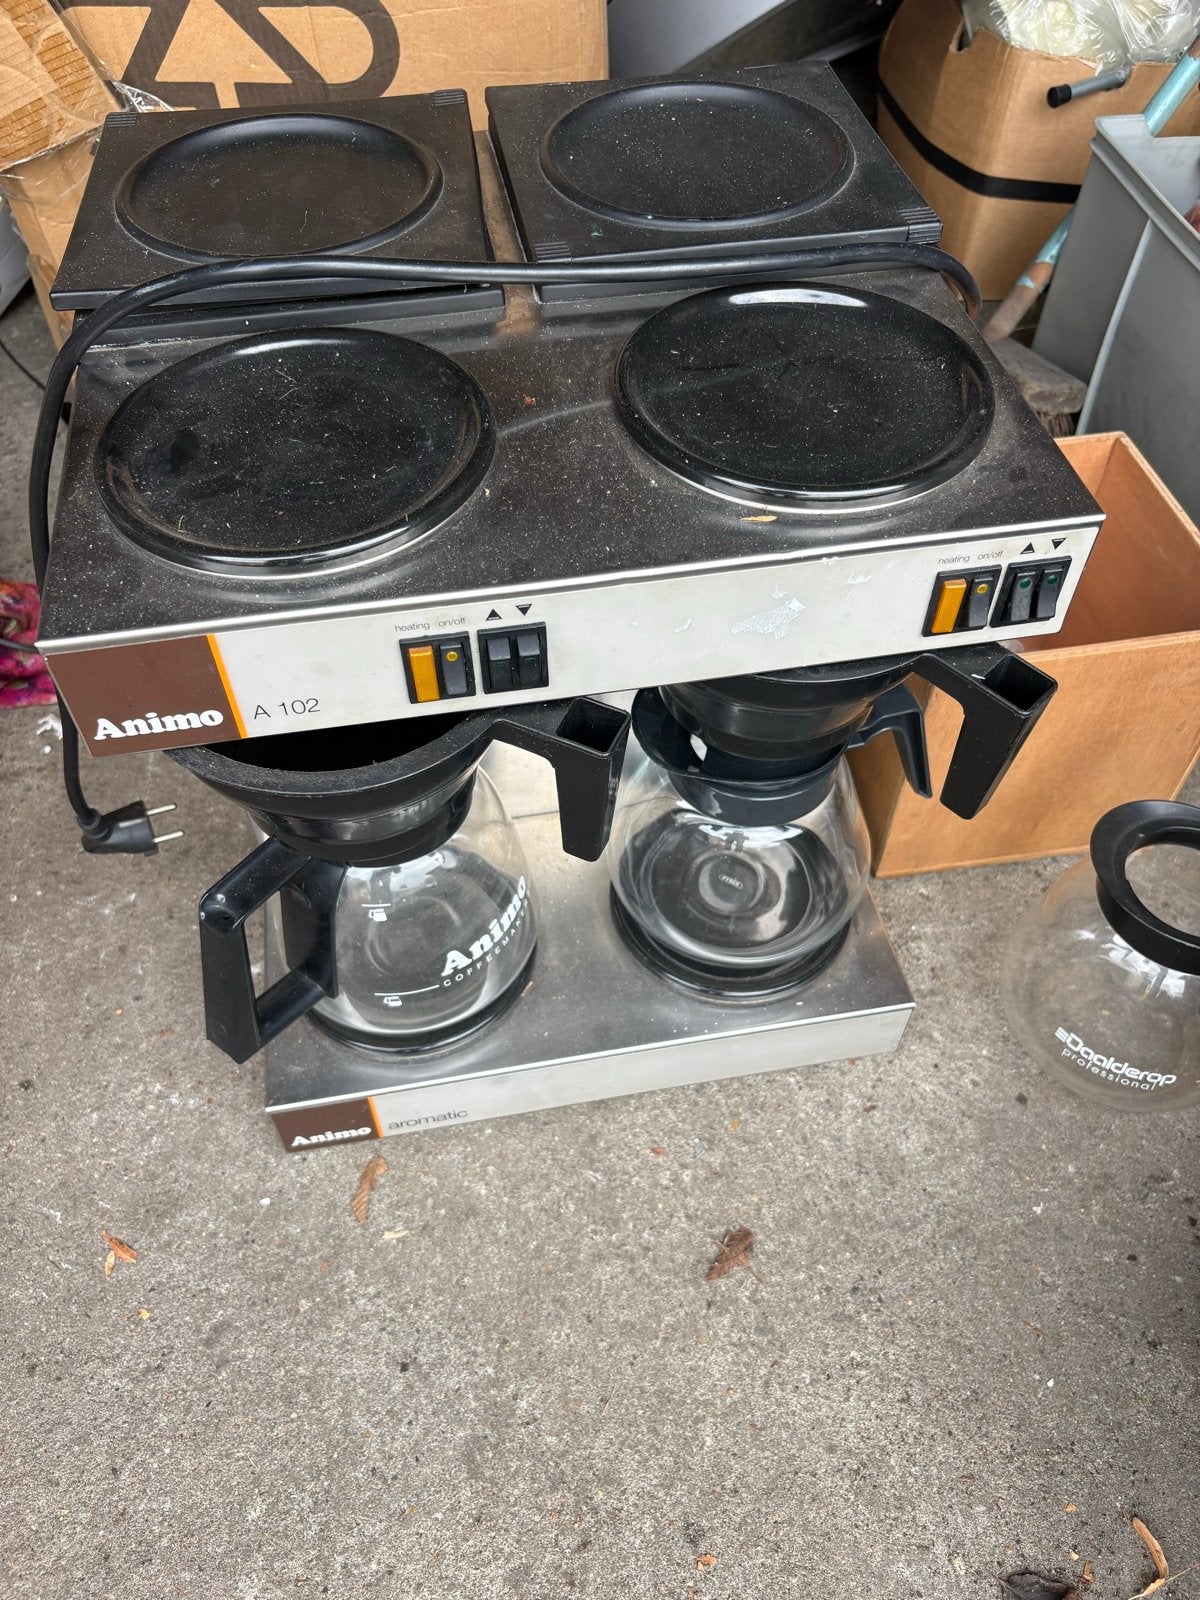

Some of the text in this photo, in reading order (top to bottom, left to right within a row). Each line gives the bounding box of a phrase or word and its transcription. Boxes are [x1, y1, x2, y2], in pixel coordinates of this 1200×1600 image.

[938, 551, 1003, 565] heating on/off
[395, 617, 466, 632] heating on/off
[253, 697, 321, 720] A 102
[94, 710, 224, 740] Animo
[441, 875, 526, 977] Animo
[1060, 1047, 1158, 1091] professional
[1065, 1032, 1177, 1086] Daalderop
[388, 1110, 469, 1130] aromatic
[291, 1126, 372, 1147] Animo
